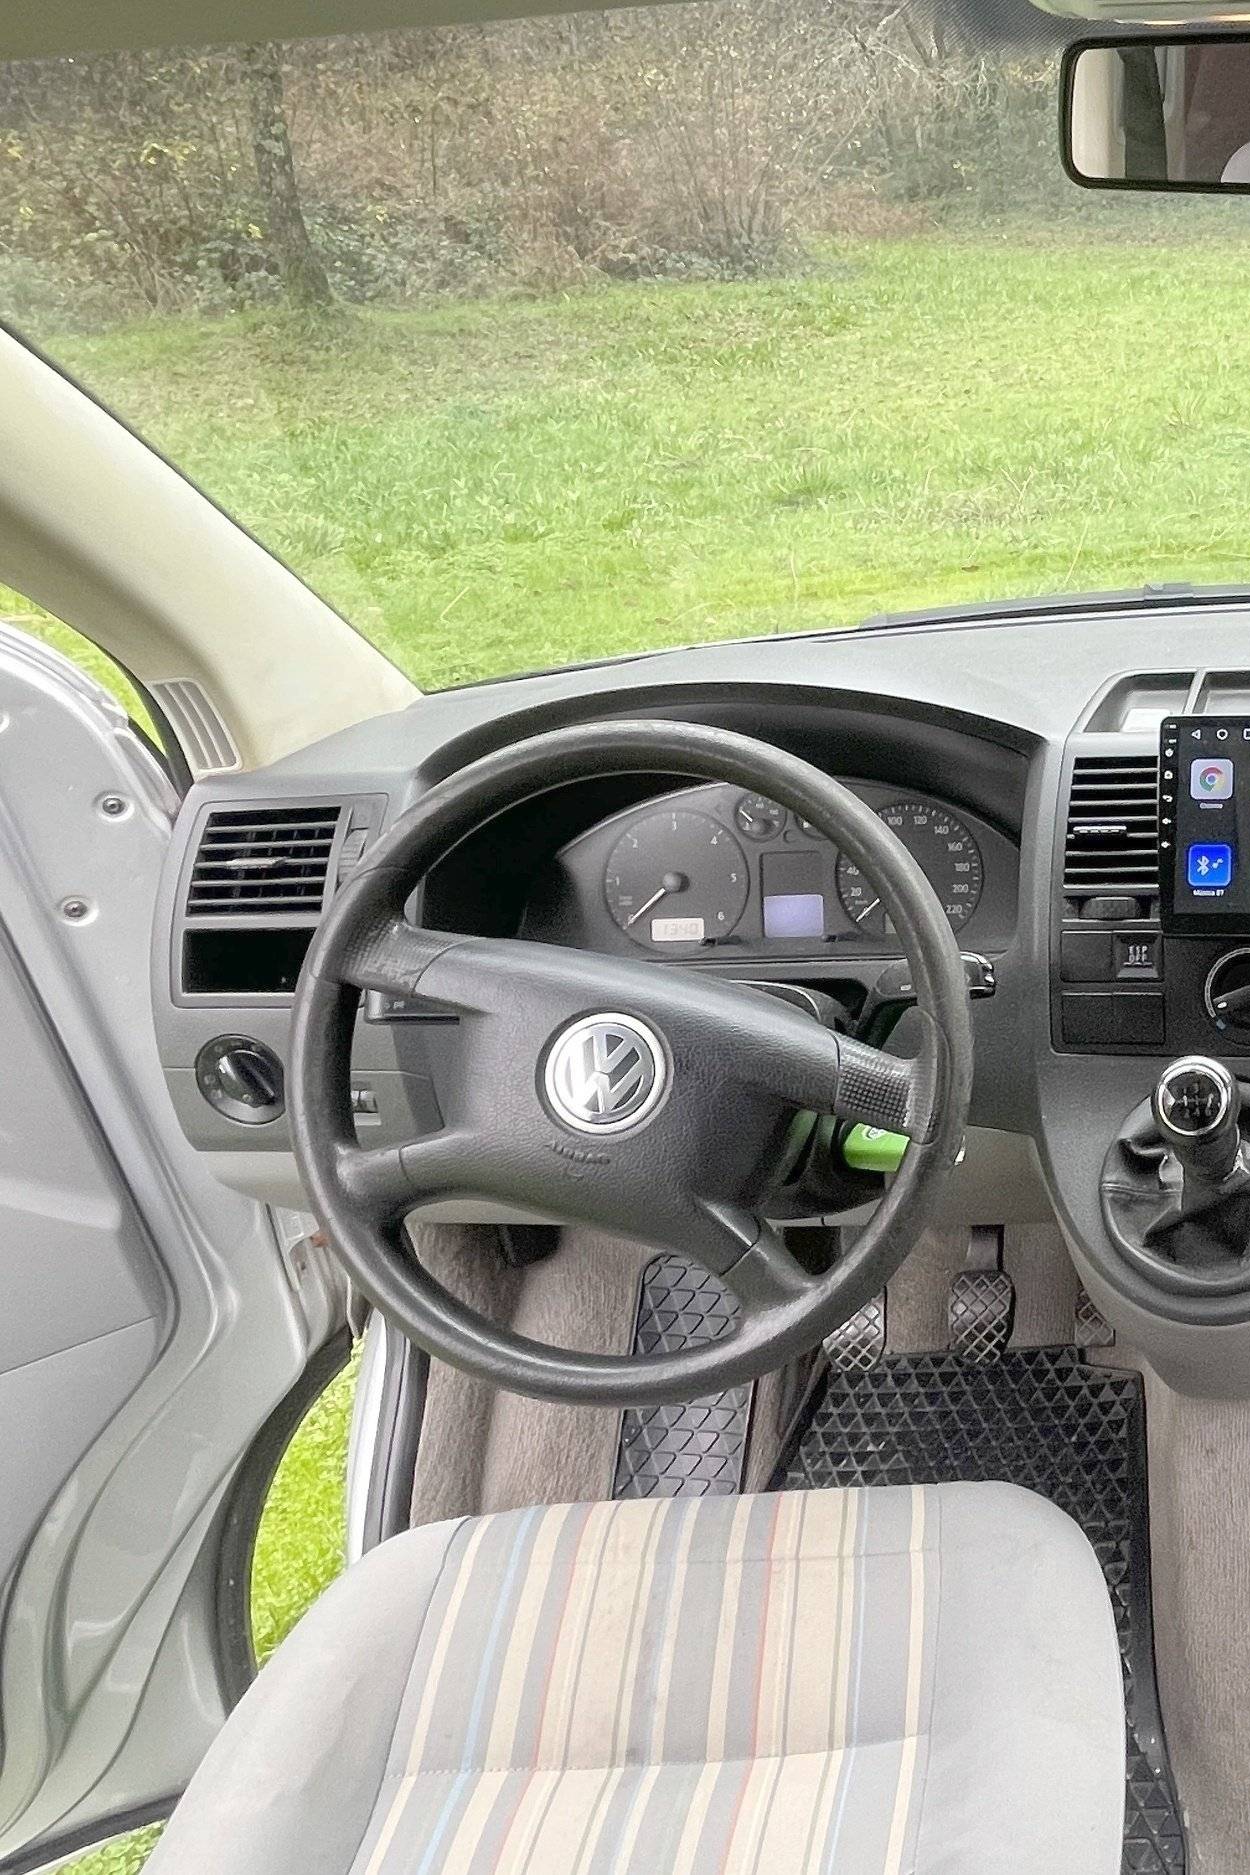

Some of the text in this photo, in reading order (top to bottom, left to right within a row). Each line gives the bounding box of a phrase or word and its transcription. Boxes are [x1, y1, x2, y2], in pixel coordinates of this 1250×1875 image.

[934, 825, 949, 835] 140
[947, 842, 963, 851] 160
[850, 887, 862, 896] 20
[953, 884, 969, 893] 200
[946, 904, 963, 914] 220
